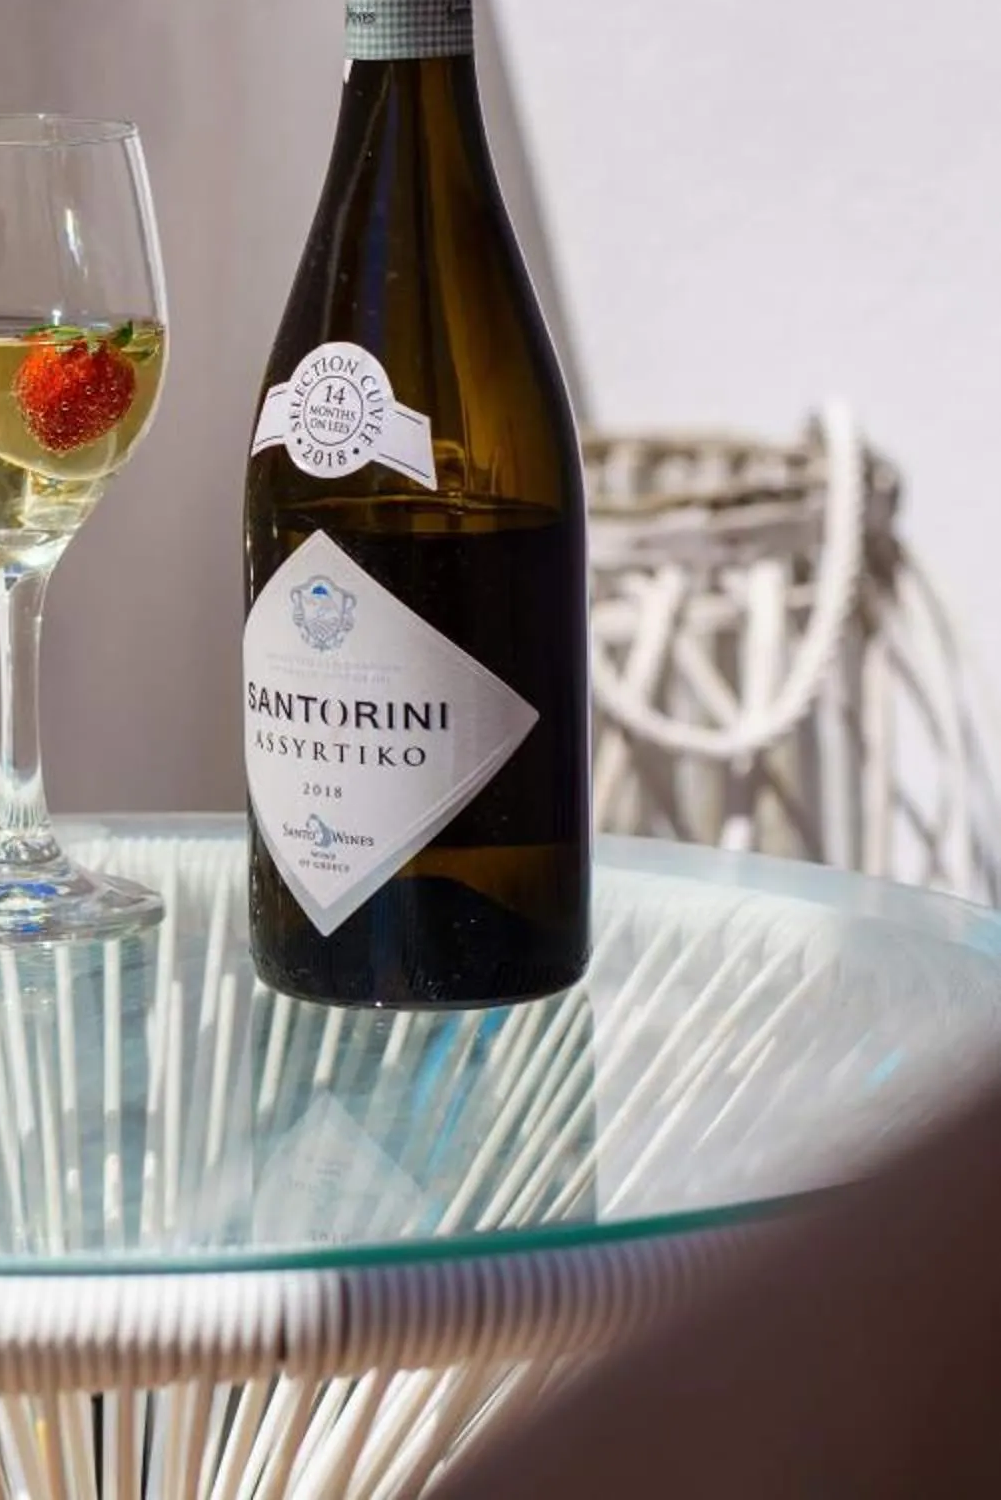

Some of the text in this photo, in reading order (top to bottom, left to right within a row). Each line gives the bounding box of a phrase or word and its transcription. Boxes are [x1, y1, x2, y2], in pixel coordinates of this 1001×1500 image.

[290, 355, 358, 432] SELECTION
[326, 385, 345, 407] 14
[309, 405, 356, 421] MONTHS
[310, 417, 326, 430] ON
[302, 444, 347, 467] 2018
[248, 681, 448, 730] SANTORINI
[255, 729, 426, 767] ASSYRTIKO
[302, 782, 343, 799] 2018
